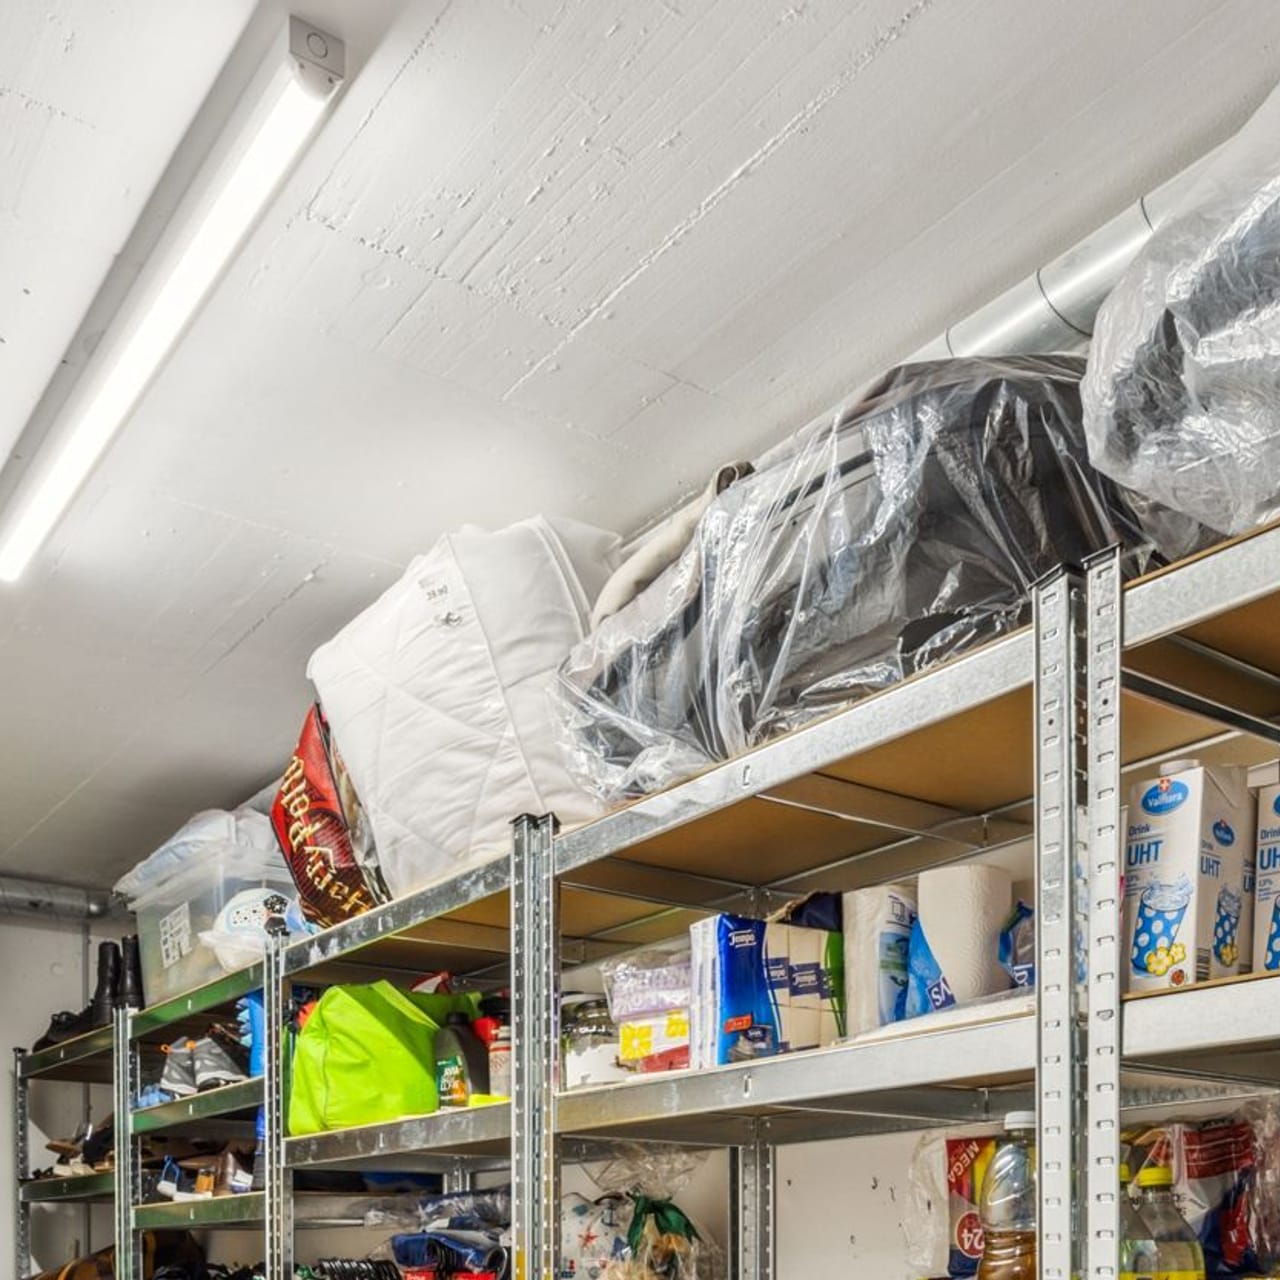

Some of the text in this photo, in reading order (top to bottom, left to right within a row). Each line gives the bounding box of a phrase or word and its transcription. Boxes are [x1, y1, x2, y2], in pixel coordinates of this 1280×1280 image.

[1129, 824, 1150, 836] Drink
[1128, 840, 1163, 866] UHT
[1200, 856, 1220, 877] UHT
[948, 1140, 980, 1183] MEGA
[962, 1229, 985, 1250] 24
